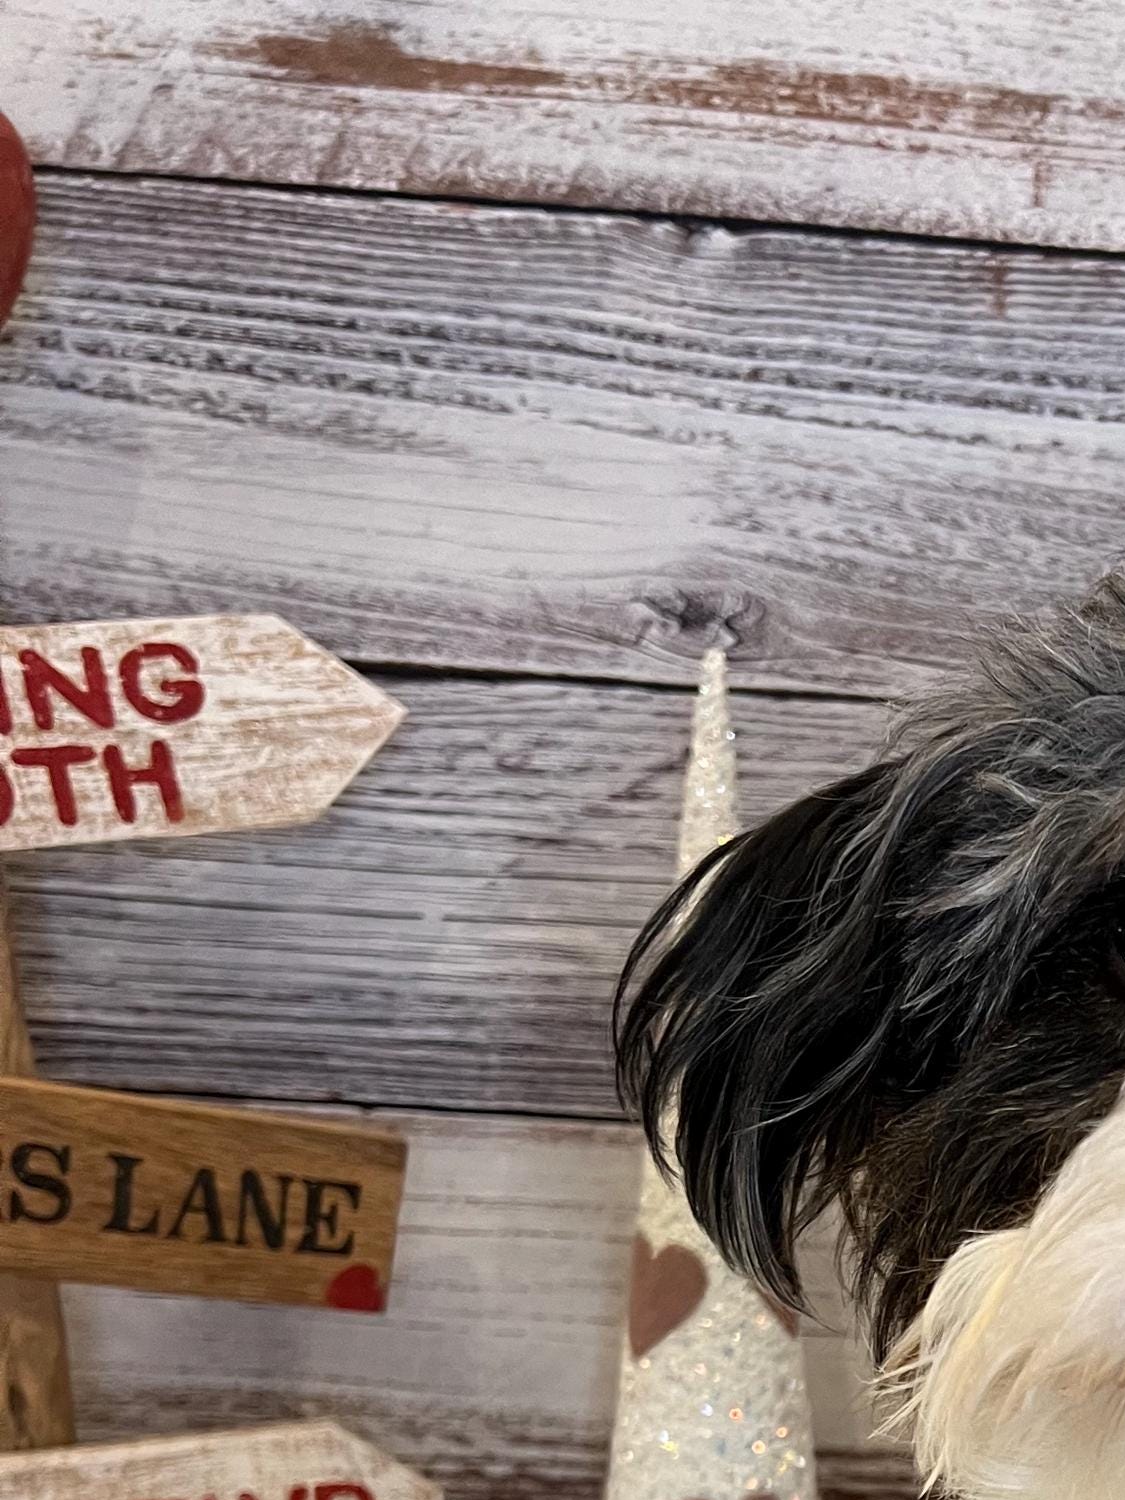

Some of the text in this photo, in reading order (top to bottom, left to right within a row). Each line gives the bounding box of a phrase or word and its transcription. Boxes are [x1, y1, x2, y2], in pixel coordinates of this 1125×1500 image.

[0, 740, 184, 828] TH
[0, 1142, 362, 1255] S LANE
